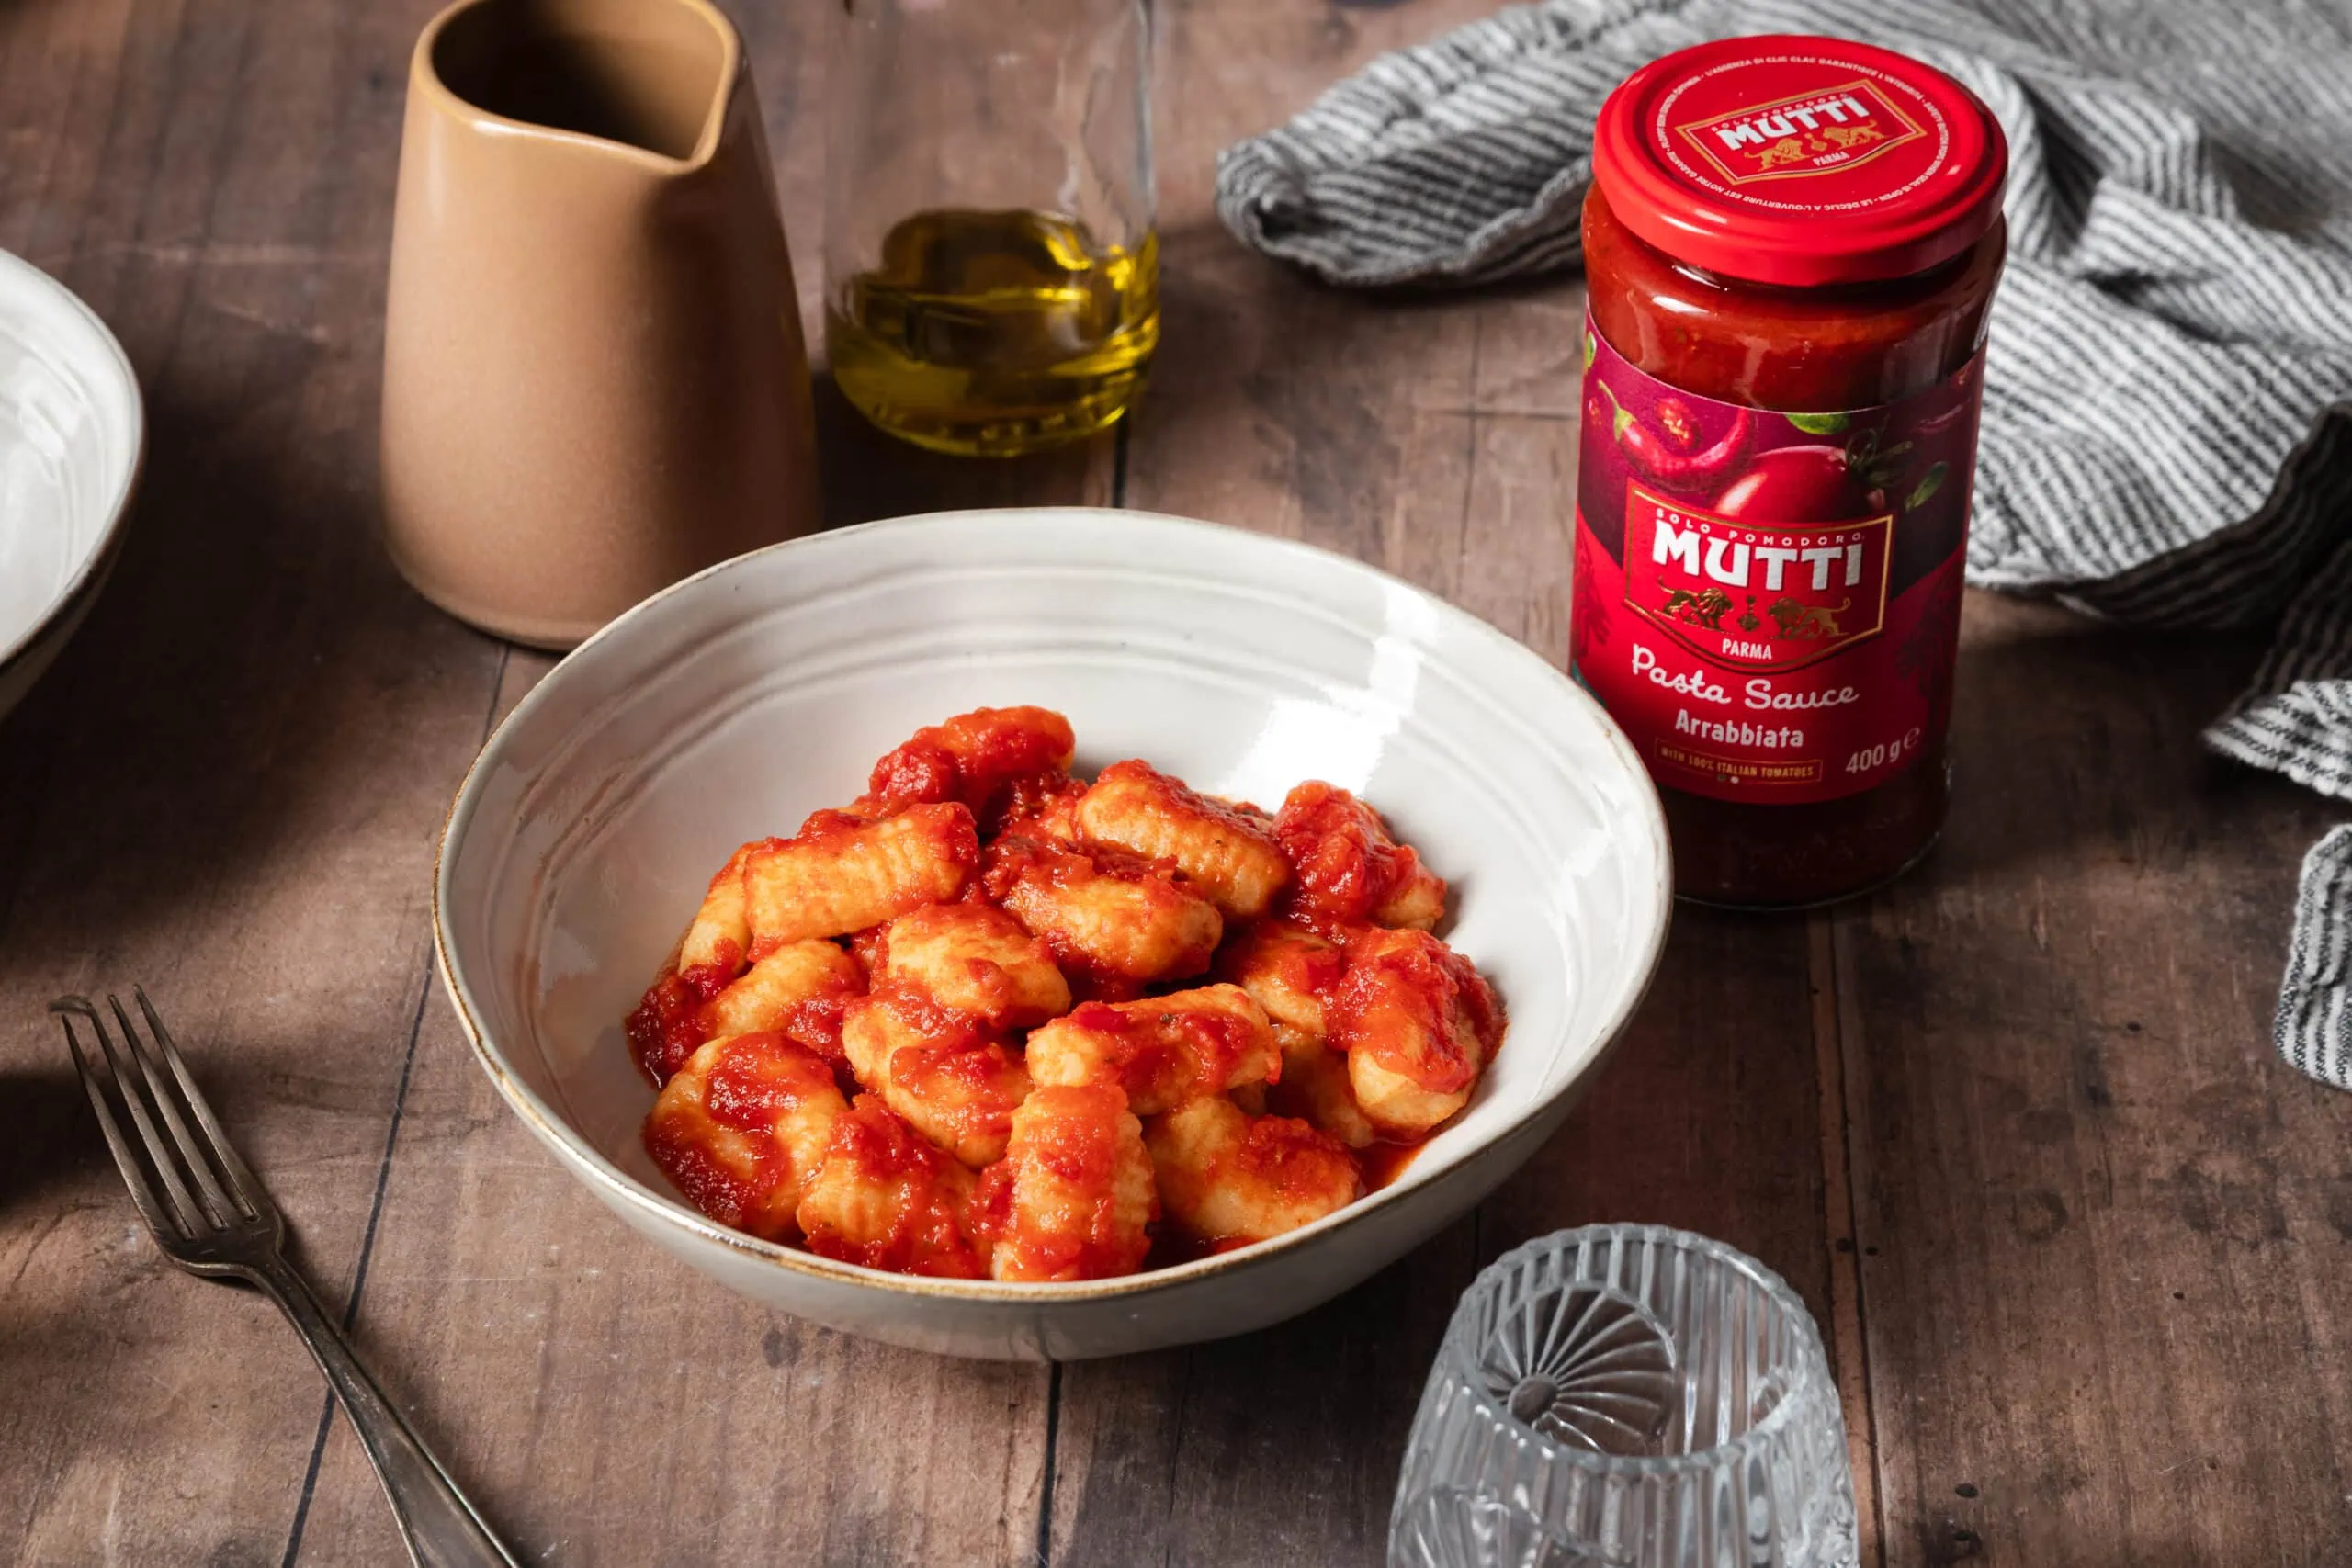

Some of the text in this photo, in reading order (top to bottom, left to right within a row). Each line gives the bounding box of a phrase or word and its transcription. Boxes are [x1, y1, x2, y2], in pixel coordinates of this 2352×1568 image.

[1716, 96, 1870, 151] MUTTI
[1813, 152, 1850, 166] PARMA
[1657, 508, 1860, 547] SOLO POMODORO
[1652, 519, 1862, 591] MUTTI
[1722, 638, 1772, 659] PARMA
[1632, 643, 1860, 709] Pasta Sauce
[1675, 709, 1804, 748] Arrabbiata
[1661, 747, 1814, 778] WITH 100% ITALIAN TOMATOES
[1845, 744, 1885, 773] 400
